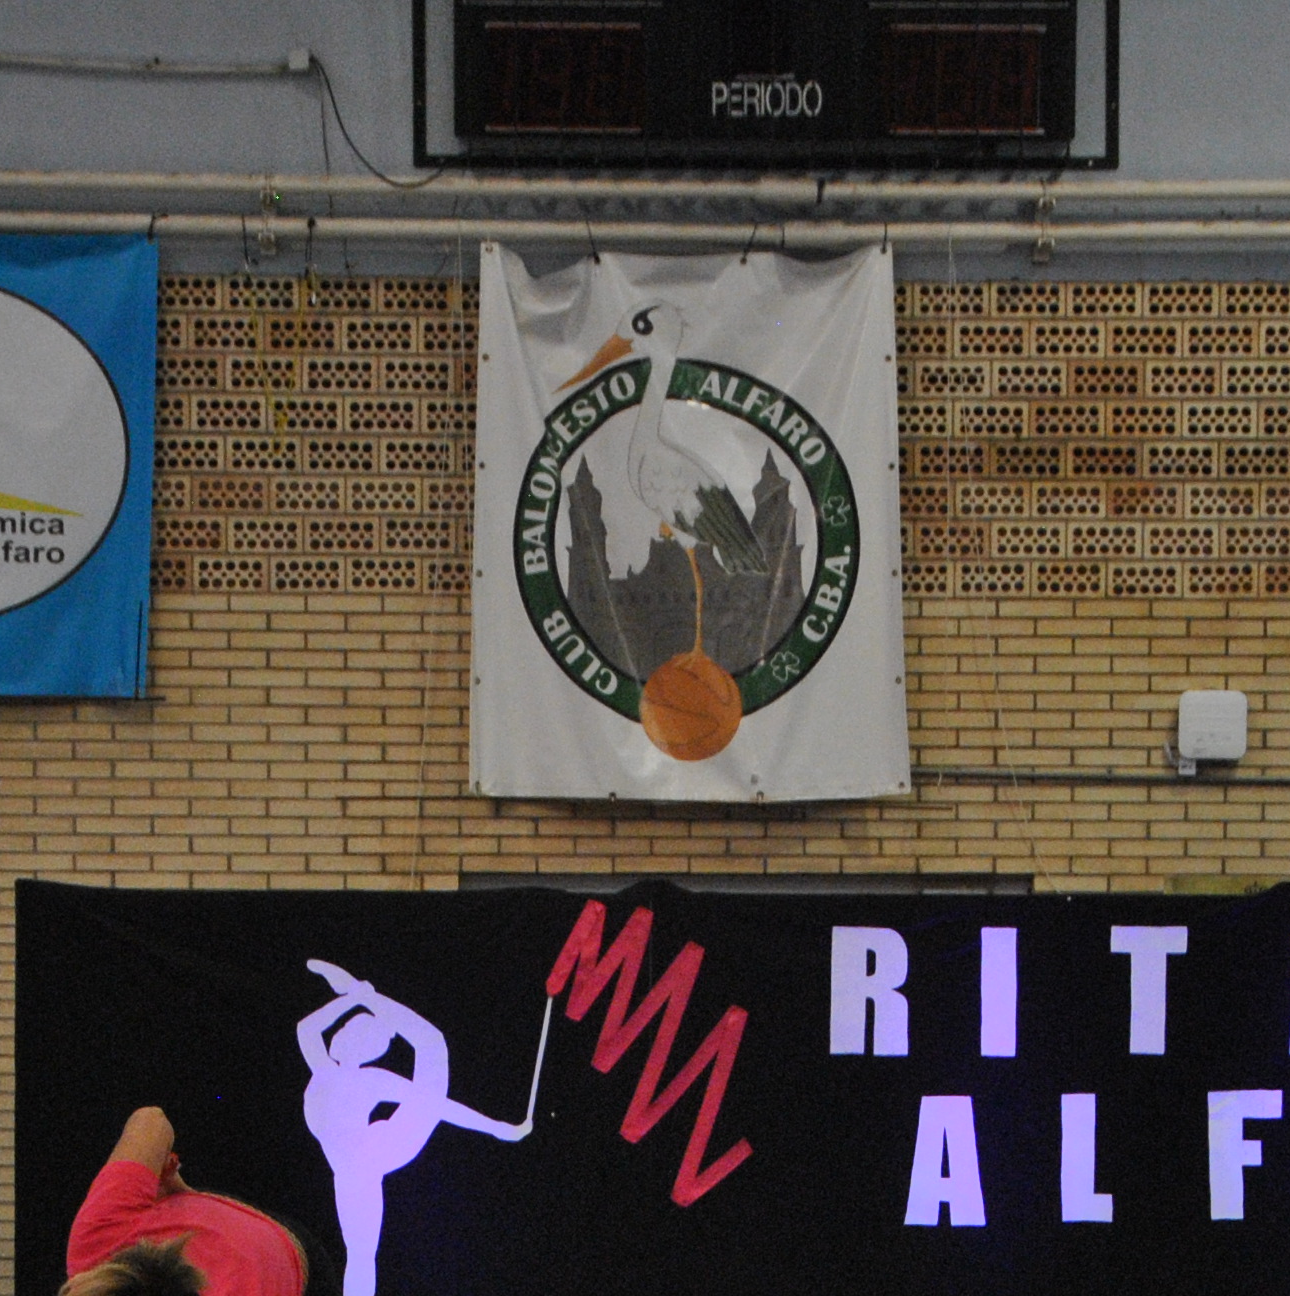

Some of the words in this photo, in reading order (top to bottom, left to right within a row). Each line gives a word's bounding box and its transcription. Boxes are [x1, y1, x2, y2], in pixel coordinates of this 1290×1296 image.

[711, 80, 822, 117] PERIODO
[697, 369, 827, 468] ALFARO
[522, 370, 638, 577] BALONCESTO
[542, 608, 619, 697] CLUB
